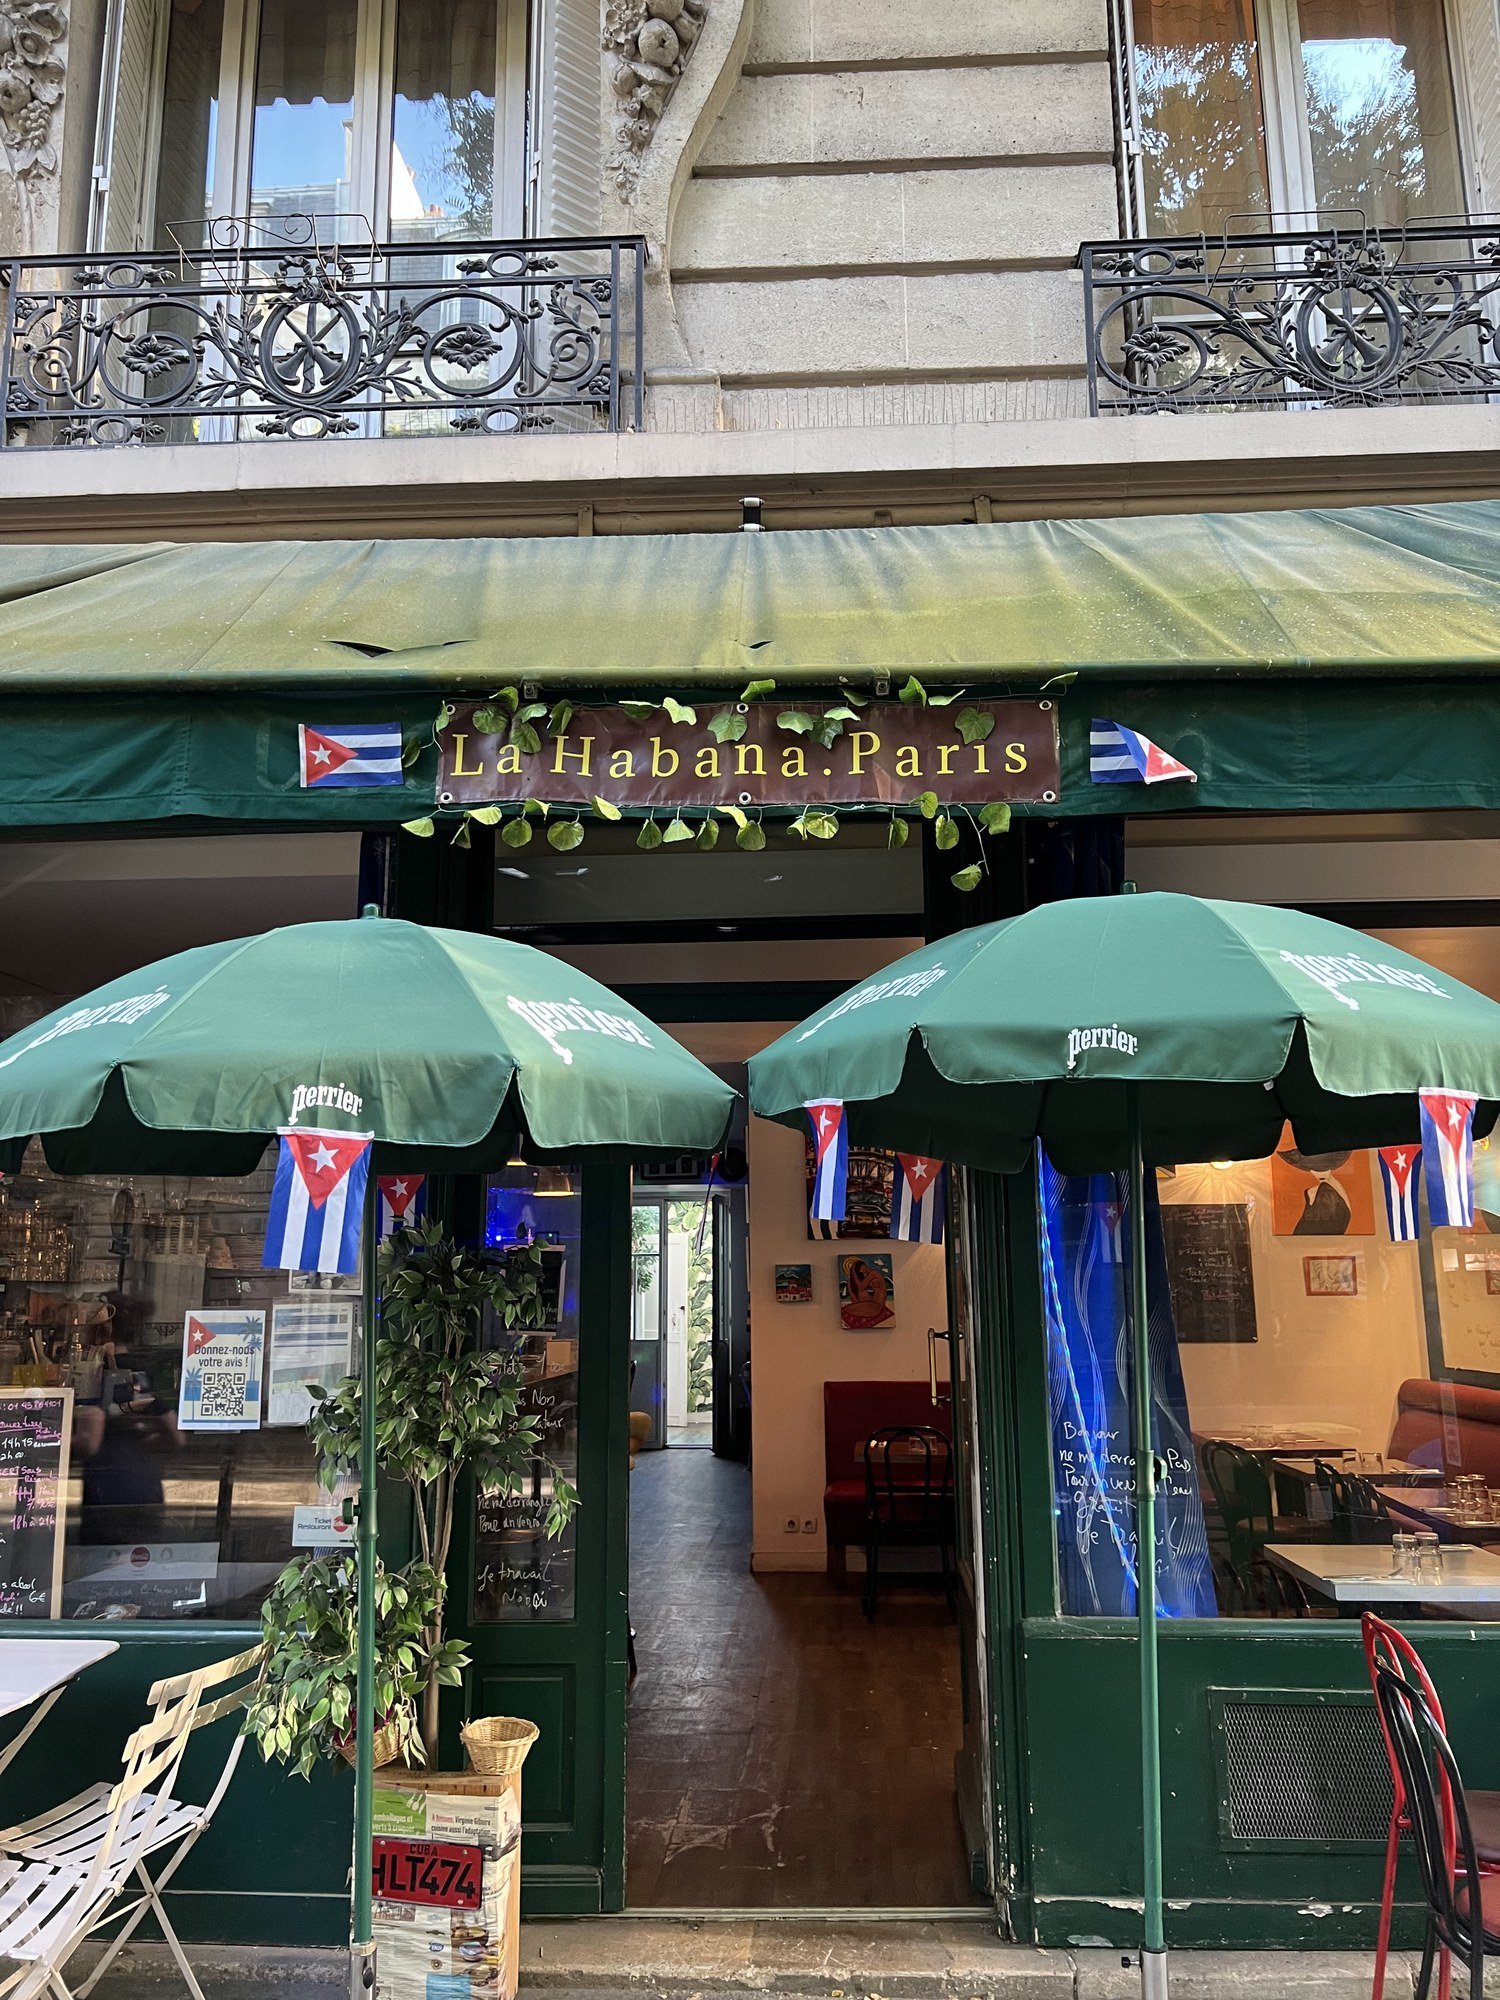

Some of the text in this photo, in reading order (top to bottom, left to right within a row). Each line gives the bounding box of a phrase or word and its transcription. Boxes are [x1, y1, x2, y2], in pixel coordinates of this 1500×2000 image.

[450, 733, 523, 778] La
[194, 1346, 255, 1355] Donnez-nous
[198, 1357, 222, 1368] votre
[225, 1357, 243, 1368] avis
[409, 1844, 438, 1856] CUBA
